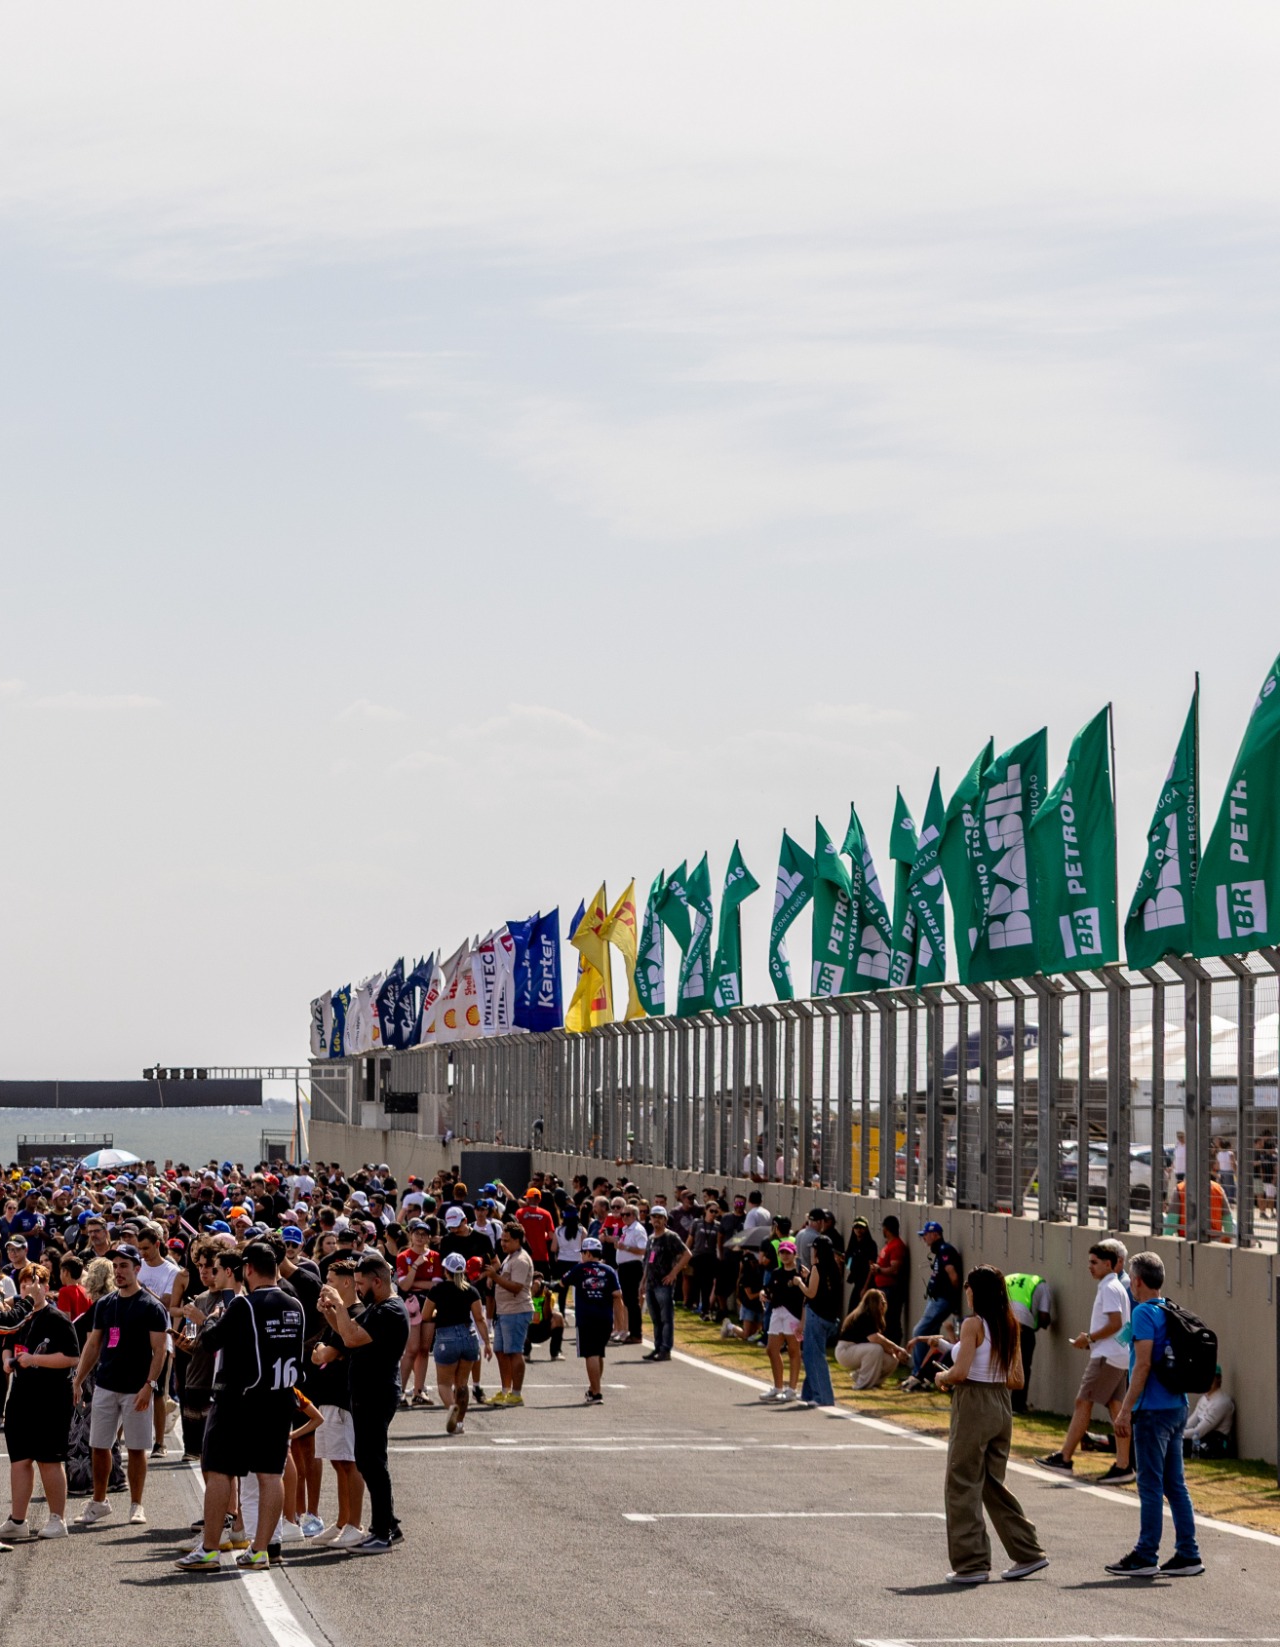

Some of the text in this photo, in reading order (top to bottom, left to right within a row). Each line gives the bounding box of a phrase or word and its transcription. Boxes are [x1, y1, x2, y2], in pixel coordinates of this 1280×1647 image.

[984, 763, 1034, 950] BRASIL
[1234, 888, 1255, 930] BR
[1077, 912, 1095, 951] BR
[483, 954, 496, 1026] MILITEC
[538, 934, 555, 1008] Karter
[820, 967, 837, 996] BR
[892, 954, 910, 987] BR
[270, 1357, 298, 1390] 16
